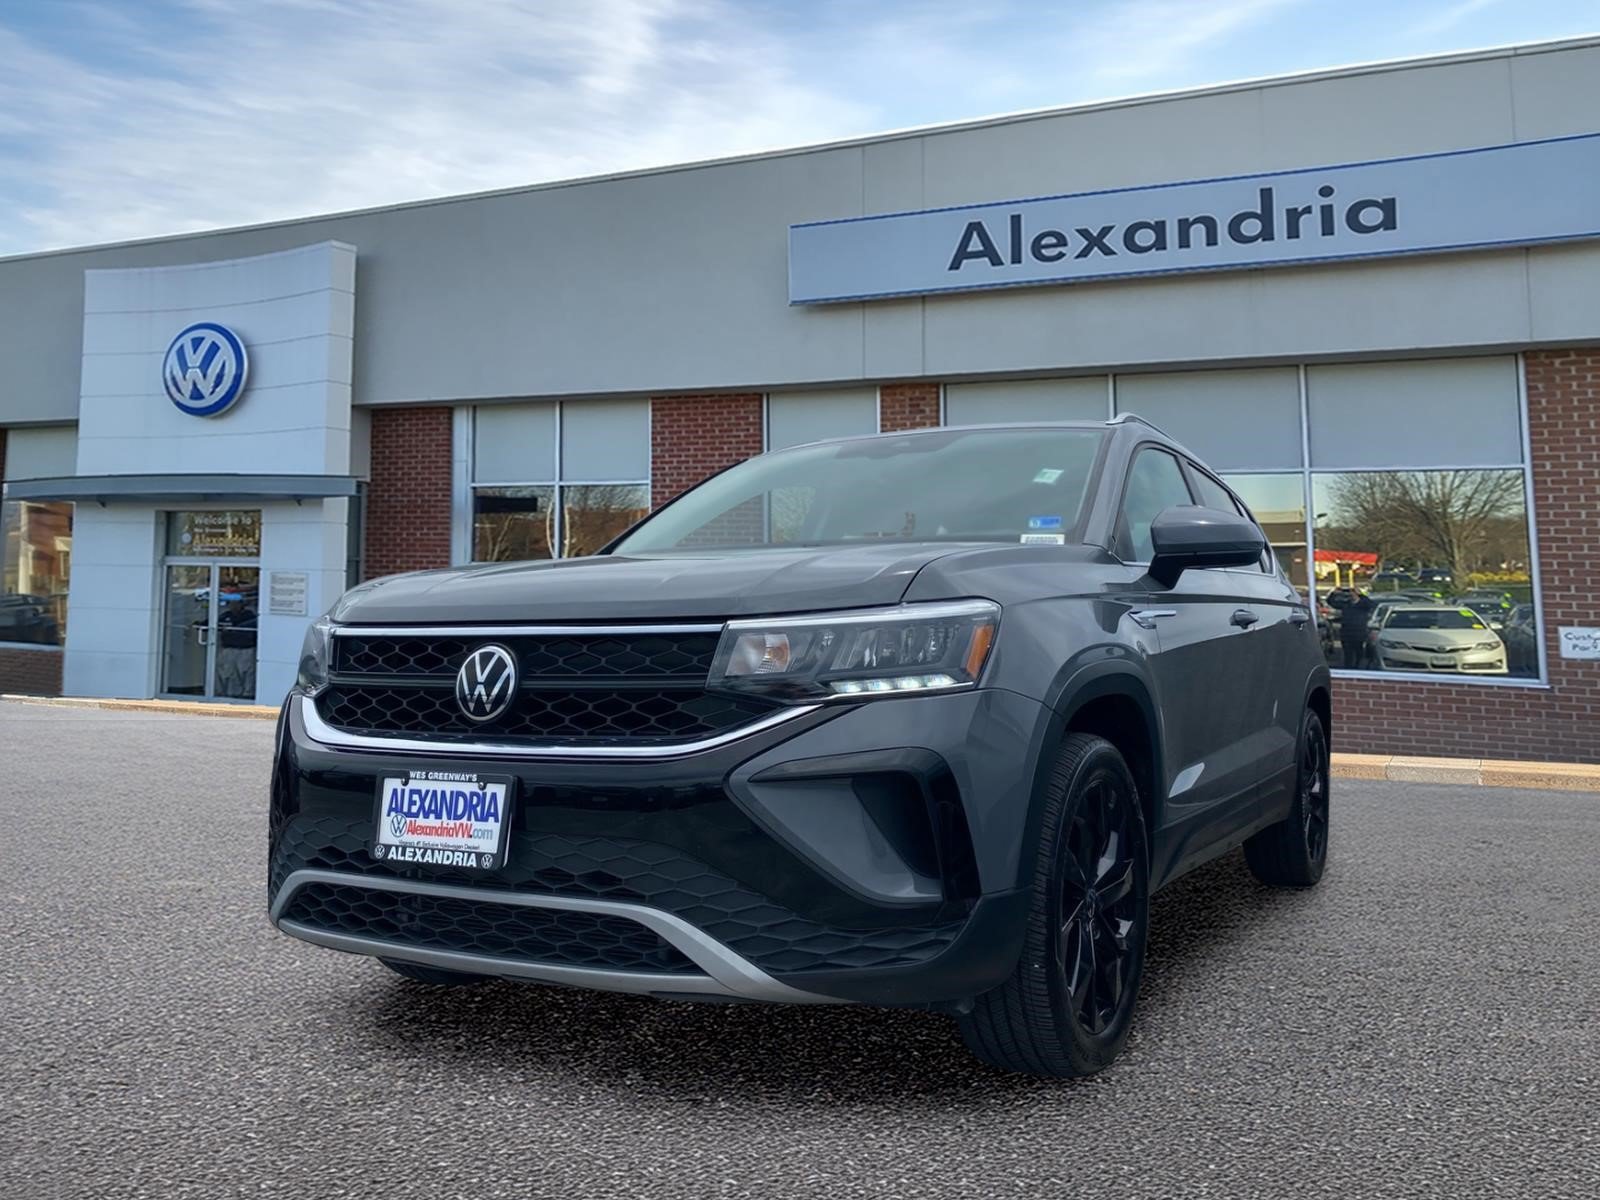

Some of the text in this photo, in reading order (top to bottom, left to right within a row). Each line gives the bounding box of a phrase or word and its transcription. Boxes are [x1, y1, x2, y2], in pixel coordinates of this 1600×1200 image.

[947, 185, 1398, 271] Alexandria
[409, 771, 478, 782] WES GREENWAY'S
[386, 788, 500, 823] ALEXANDRIA
[407, 820, 493, 840] AlexandriaVW.com
[388, 846, 477, 868] ALEXANDRIA
